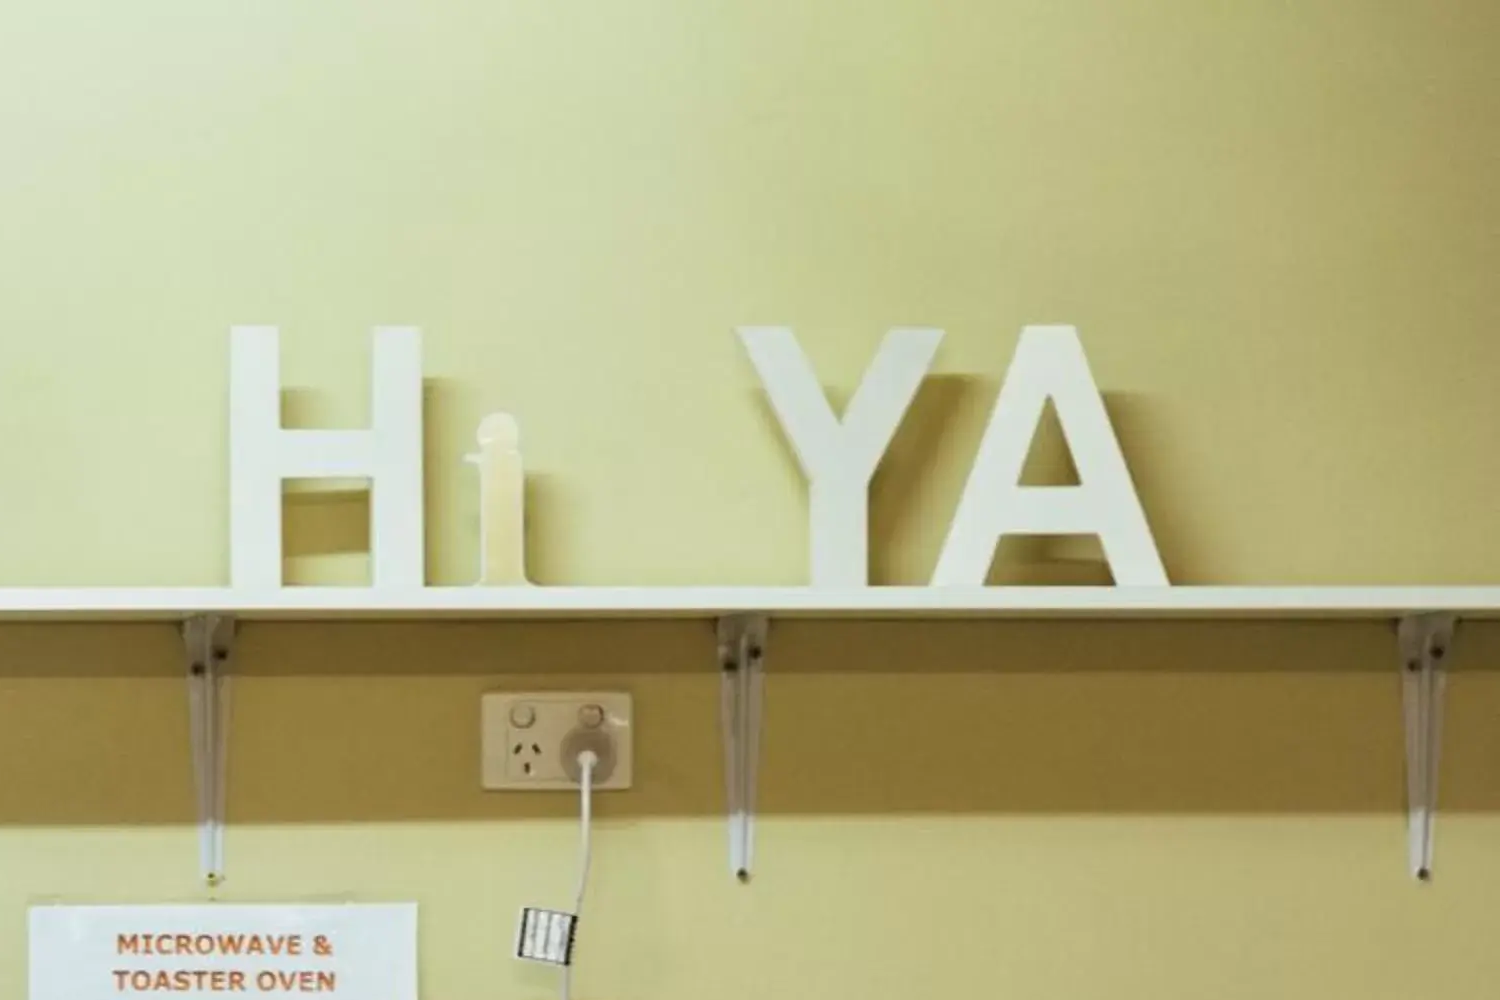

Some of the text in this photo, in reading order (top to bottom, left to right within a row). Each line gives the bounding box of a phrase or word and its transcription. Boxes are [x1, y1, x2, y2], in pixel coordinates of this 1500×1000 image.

[734, 325, 1172, 588] YA
[116, 933, 333, 956] MICROWAVE &
[112, 969, 337, 992] TOASTER OVEN
